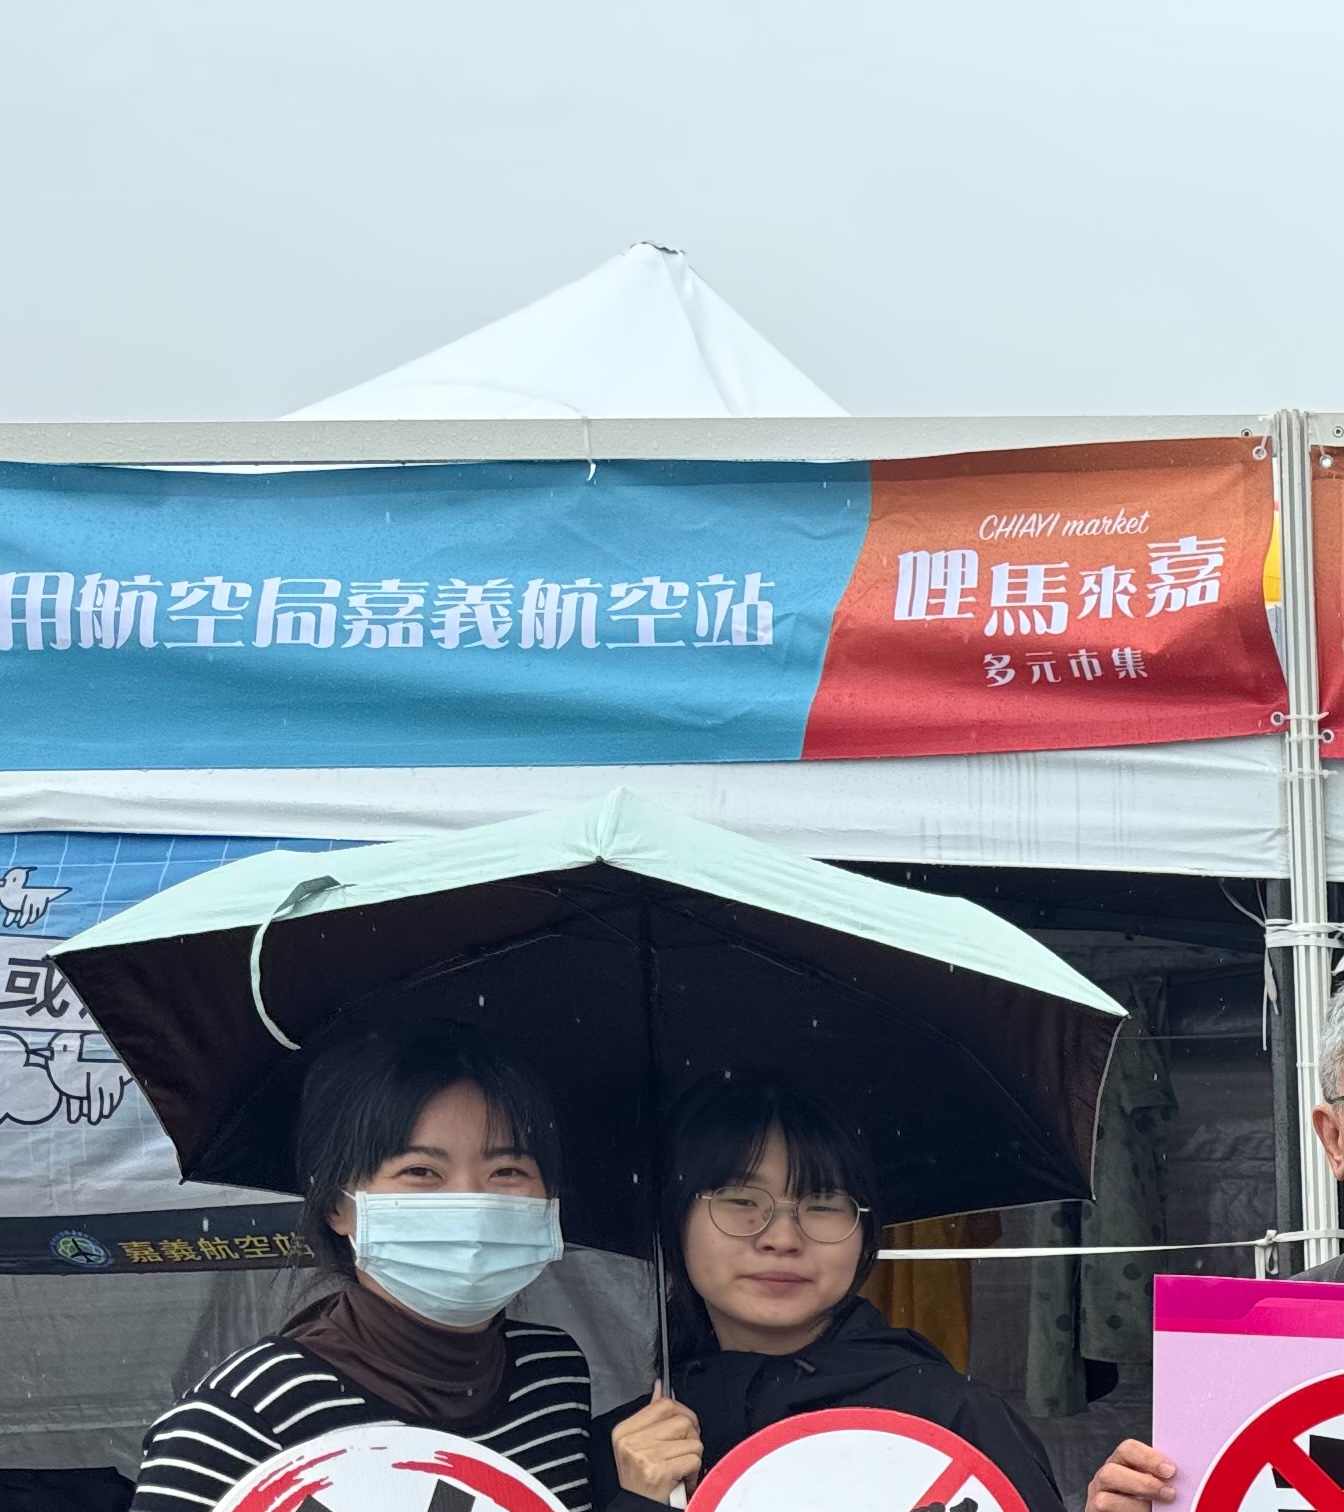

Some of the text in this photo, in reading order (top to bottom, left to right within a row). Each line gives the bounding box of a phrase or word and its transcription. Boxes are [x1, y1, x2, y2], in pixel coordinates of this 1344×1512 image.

[979, 508, 1150, 541] CHIAYI market
[0, 571, 775, 650] 用航空局嘉義航空站
[894, 536, 1227, 637] 哩馬來嘉
[983, 647, 1148, 687] 多元市集
